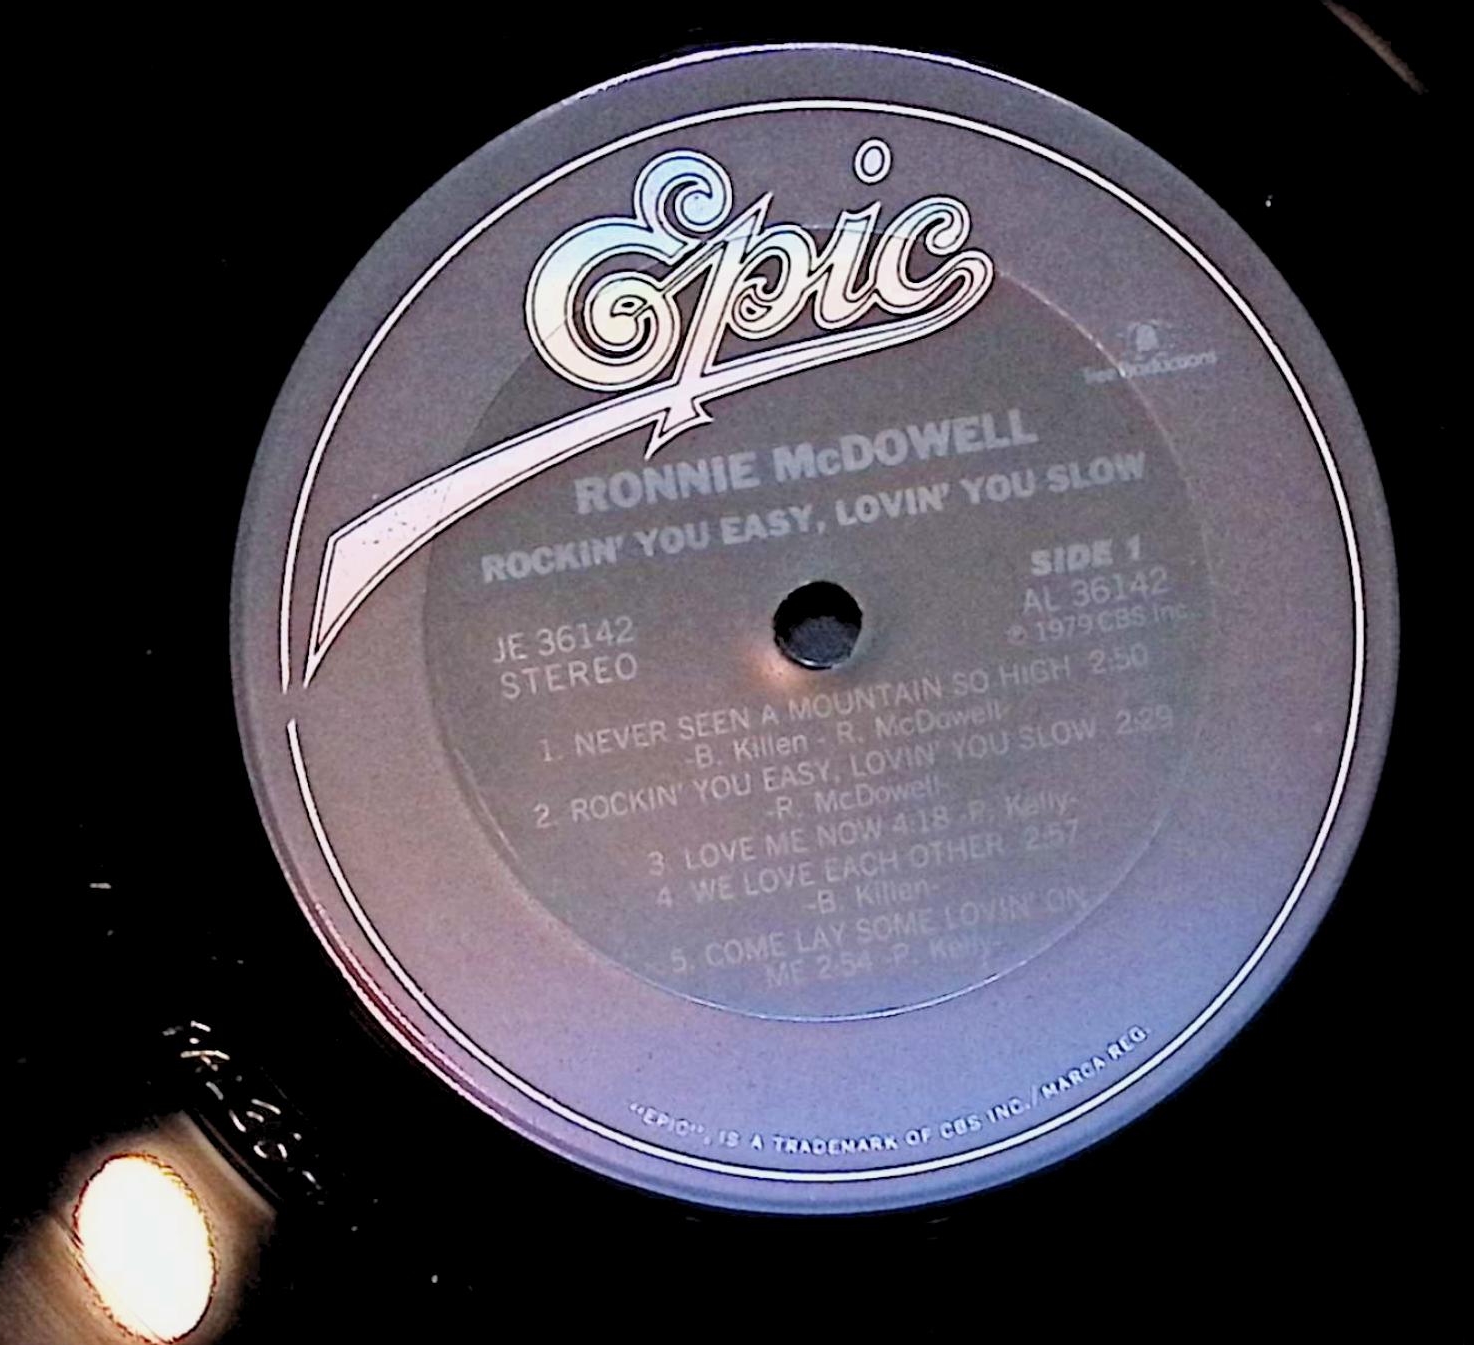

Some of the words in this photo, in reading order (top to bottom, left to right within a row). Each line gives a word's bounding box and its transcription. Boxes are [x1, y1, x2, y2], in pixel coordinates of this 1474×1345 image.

[574, 451, 761, 515] RONNIE
[773, 409, 1039, 483] McDOWELL
[481, 535, 622, 584] ROCKIN'
[633, 522, 710, 557] YOU
[720, 505, 826, 546] EASY,
[835, 483, 950, 526] LOVIN'
[960, 470, 1035, 505] YOU
[1046, 452, 1147, 493] SLOW
[1030, 538, 1114, 577] SIDE
[1126, 533, 1141, 561] 1
[1023, 585, 1062, 615] AL
[1069, 566, 1170, 608] 36142
[493, 632, 528, 664] JE
[538, 616, 635, 655] 36142
[1035, 615, 1093, 642] 1979
[1097, 604, 1147, 633] CBS
[500, 652, 639, 700] STEREO
[574, 719, 669, 757] NEVER
[677, 707, 751, 742] SEEN
[761, 703, 780, 727] A
[788, 675, 943, 721] MOUNTAIN
[951, 668, 989, 697] SO
[998, 654, 1071, 687] HIGH
[1089, 641, 1148, 675] 2:50
[732, 734, 809, 763] Killen
[836, 720, 865, 745] R.
[570, 782, 683, 823] ROCKIN'
[692, 772, 752, 804] YOU
[762, 758, 841, 793] EASY,
[850, 739, 940, 778] LOVIN'
[951, 729, 1010, 760] YOU
[1018, 717, 1097, 753] SLOW
[685, 836, 758, 871] LOVE
[765, 827, 810, 858] ME
[816, 815, 883, 849] NOW
[891, 804, 950, 836] 4:18
[689, 874, 736, 905] WE
[743, 861, 817, 896] LOVE
[824, 847, 901, 883] EACH
[908, 831, 1006, 869] OTHER
[1024, 815, 1080, 851] 2:57
[705, 931, 788, 967] COME
[794, 920, 846, 953] LAY
[854, 905, 938, 945] SOME
[1045, 885, 1088, 913] ON
[766, 958, 807, 989] ME
[718, 1130, 739, 1148] IS
[751, 1134, 764, 1151] A
[772, 1133, 899, 1155] TRADEMARK
[906, 1127, 932, 1147] OF
[940, 1115, 982, 1139] CBS
